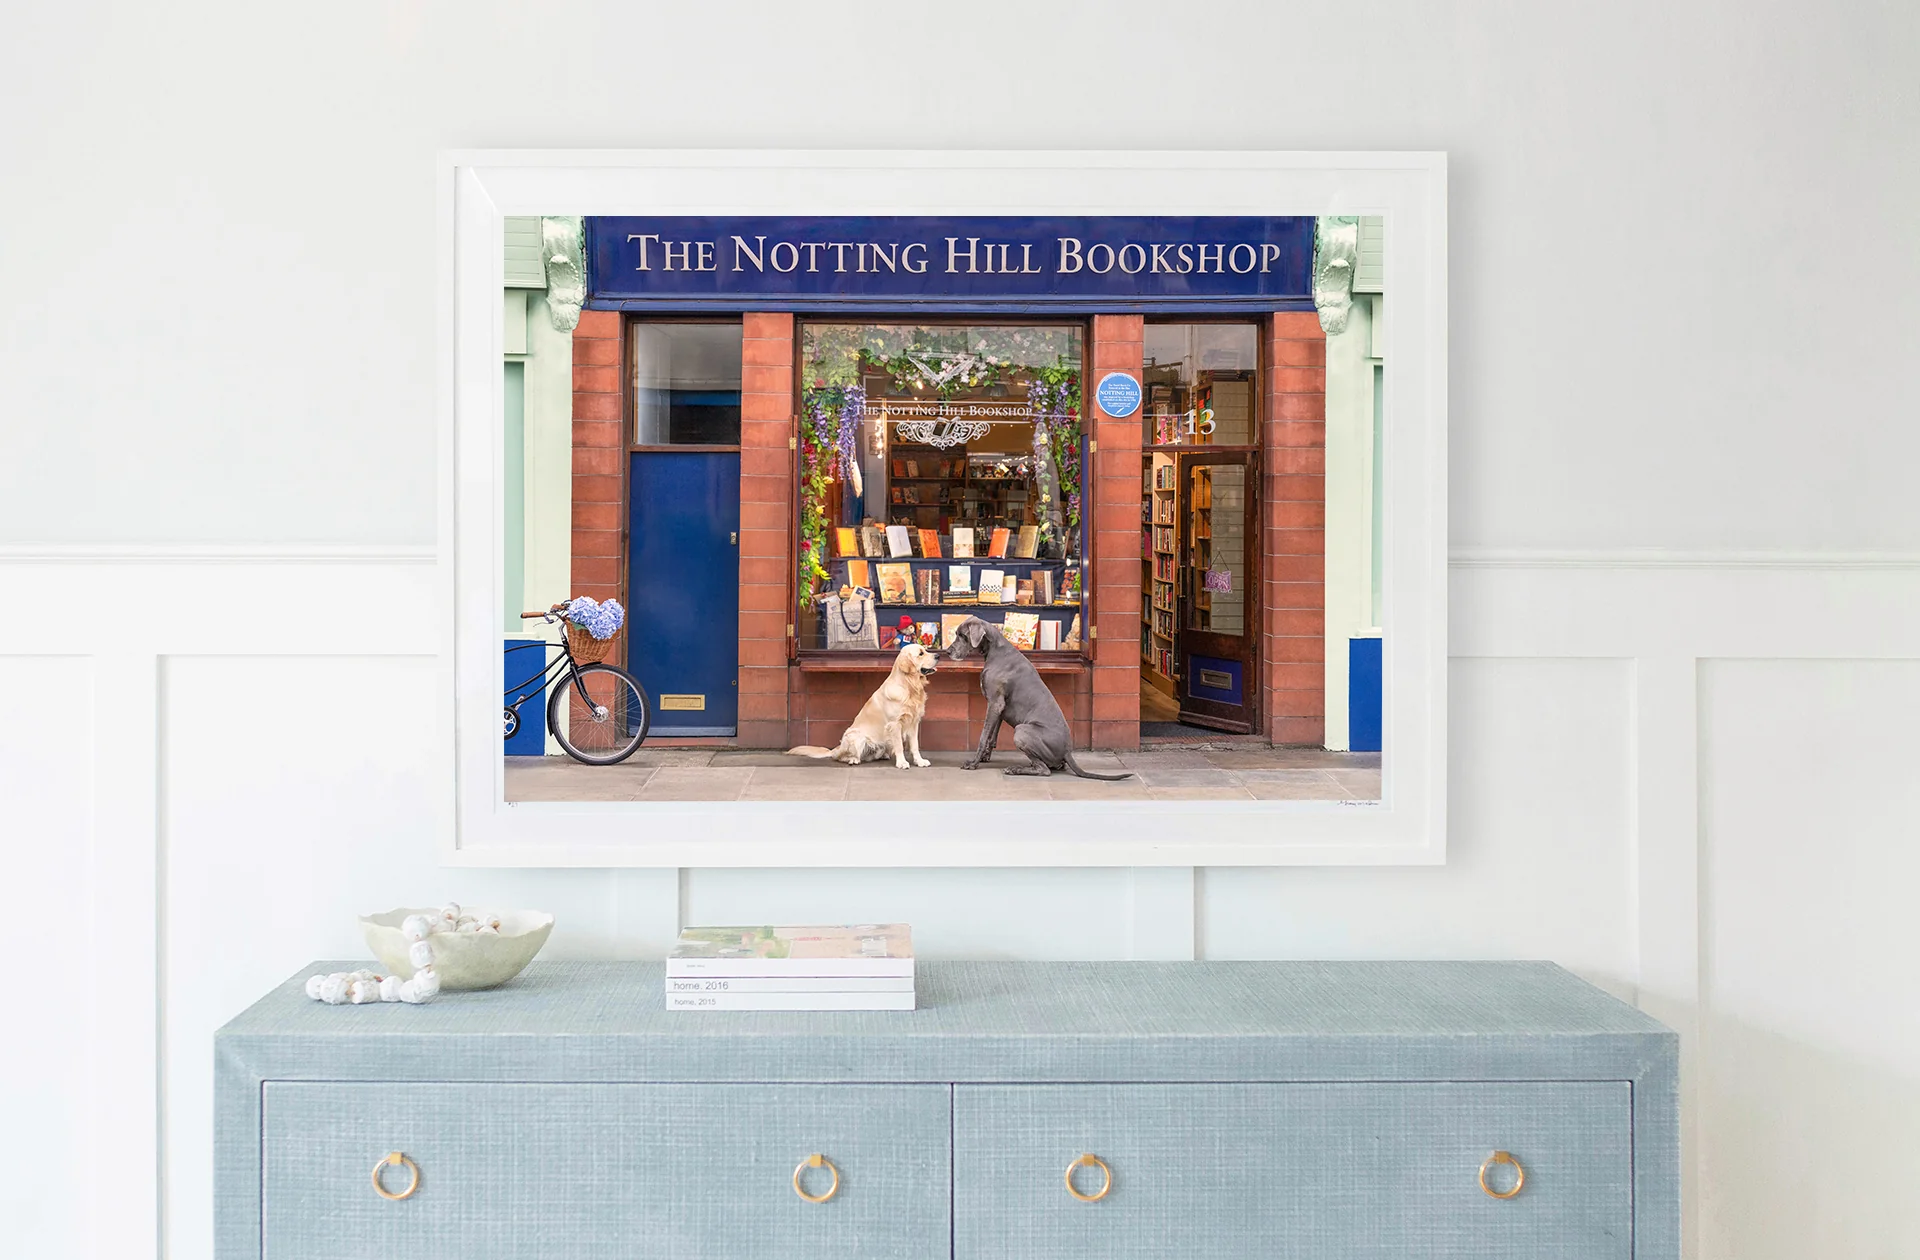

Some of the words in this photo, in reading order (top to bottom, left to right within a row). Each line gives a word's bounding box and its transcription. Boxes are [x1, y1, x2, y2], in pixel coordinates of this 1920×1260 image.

[627, 233, 718, 271] THE
[730, 235, 929, 274] NOTTING
[944, 237, 1042, 274] HILL
[1056, 237, 1281, 275] BOOKSHOP
[854, 404, 879, 416] THE
[881, 404, 936, 416] NOTTING
[939, 405, 967, 417] HILL
[969, 405, 1033, 417] BOOKSHOP
[1184, 408, 1217, 436] 13
[705, 981, 729, 990] 2016
[698, 998, 716, 1006] 2015
